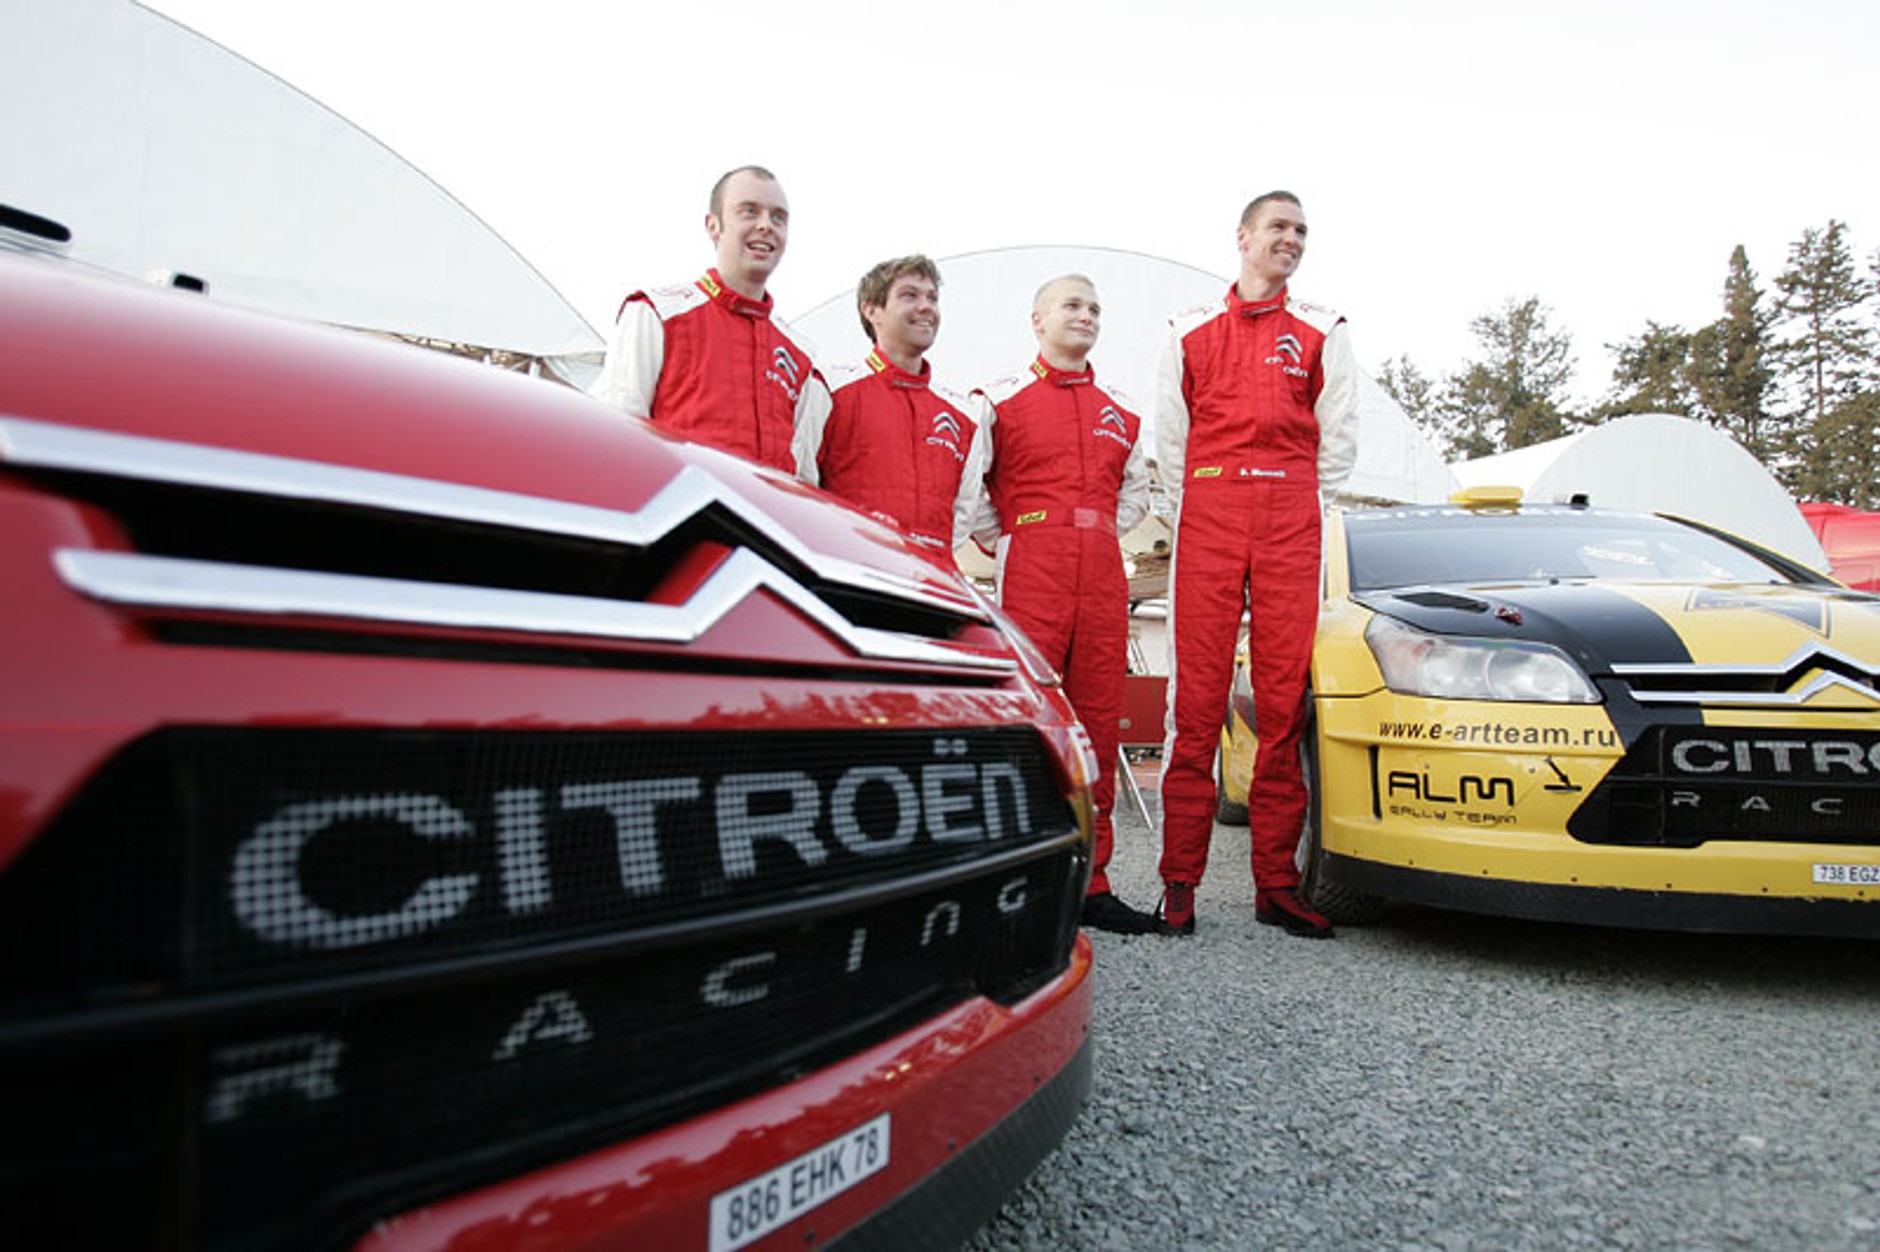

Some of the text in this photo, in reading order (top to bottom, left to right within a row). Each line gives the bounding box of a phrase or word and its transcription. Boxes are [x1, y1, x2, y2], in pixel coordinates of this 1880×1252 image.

[1379, 722, 1616, 747] www.e-artteam.ru
[1672, 739, 1880, 774] CITR
[1388, 770, 1515, 806] ALM
[1389, 805, 1517, 825] RALLY TEAM
[1819, 866, 1880, 883] 738 EGZ
[727, 1127, 879, 1241] 886 EHK 78
